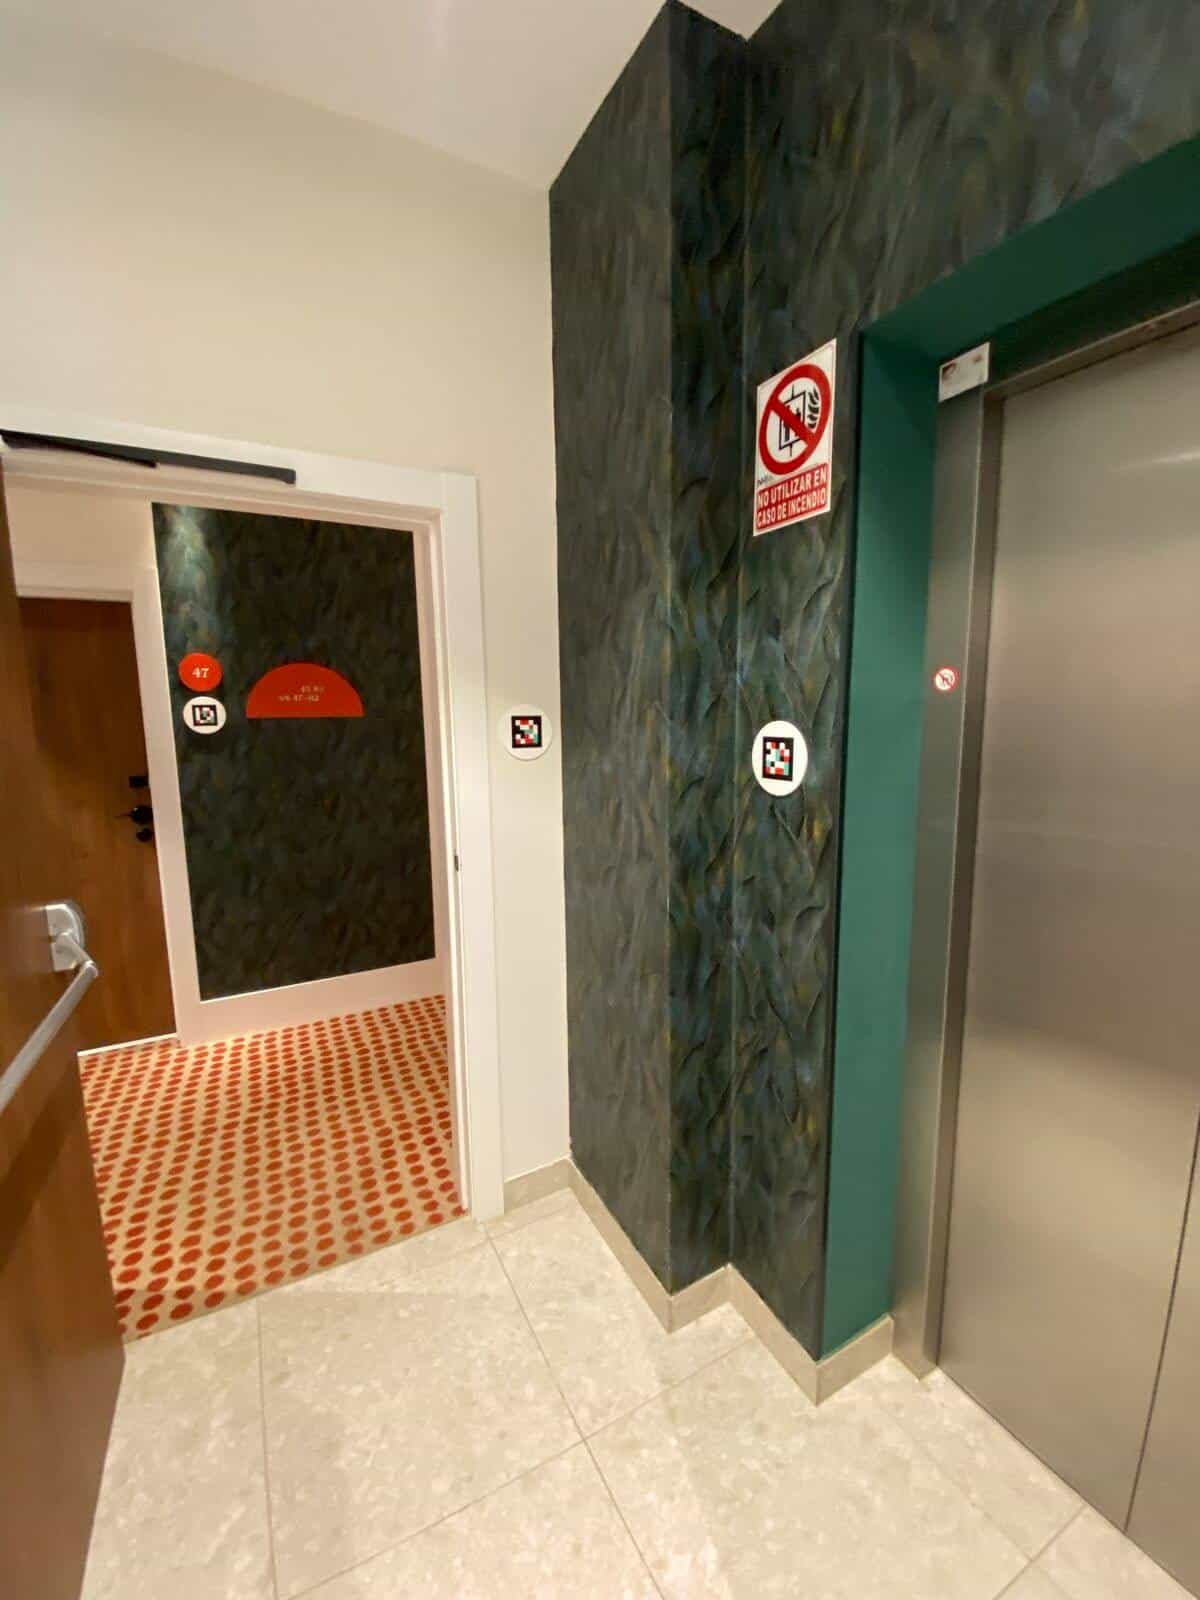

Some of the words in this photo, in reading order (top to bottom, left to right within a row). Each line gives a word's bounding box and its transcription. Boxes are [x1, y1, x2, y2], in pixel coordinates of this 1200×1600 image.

[757, 507, 776, 527] CASO
[777, 502, 787, 520] DE
[788, 487, 826, 514] INCENDIO
[758, 491, 769, 508] NO
[771, 473, 812, 502] UTILIZAR
[814, 466, 827, 486] EN
[192, 667, 209, 678] 47
